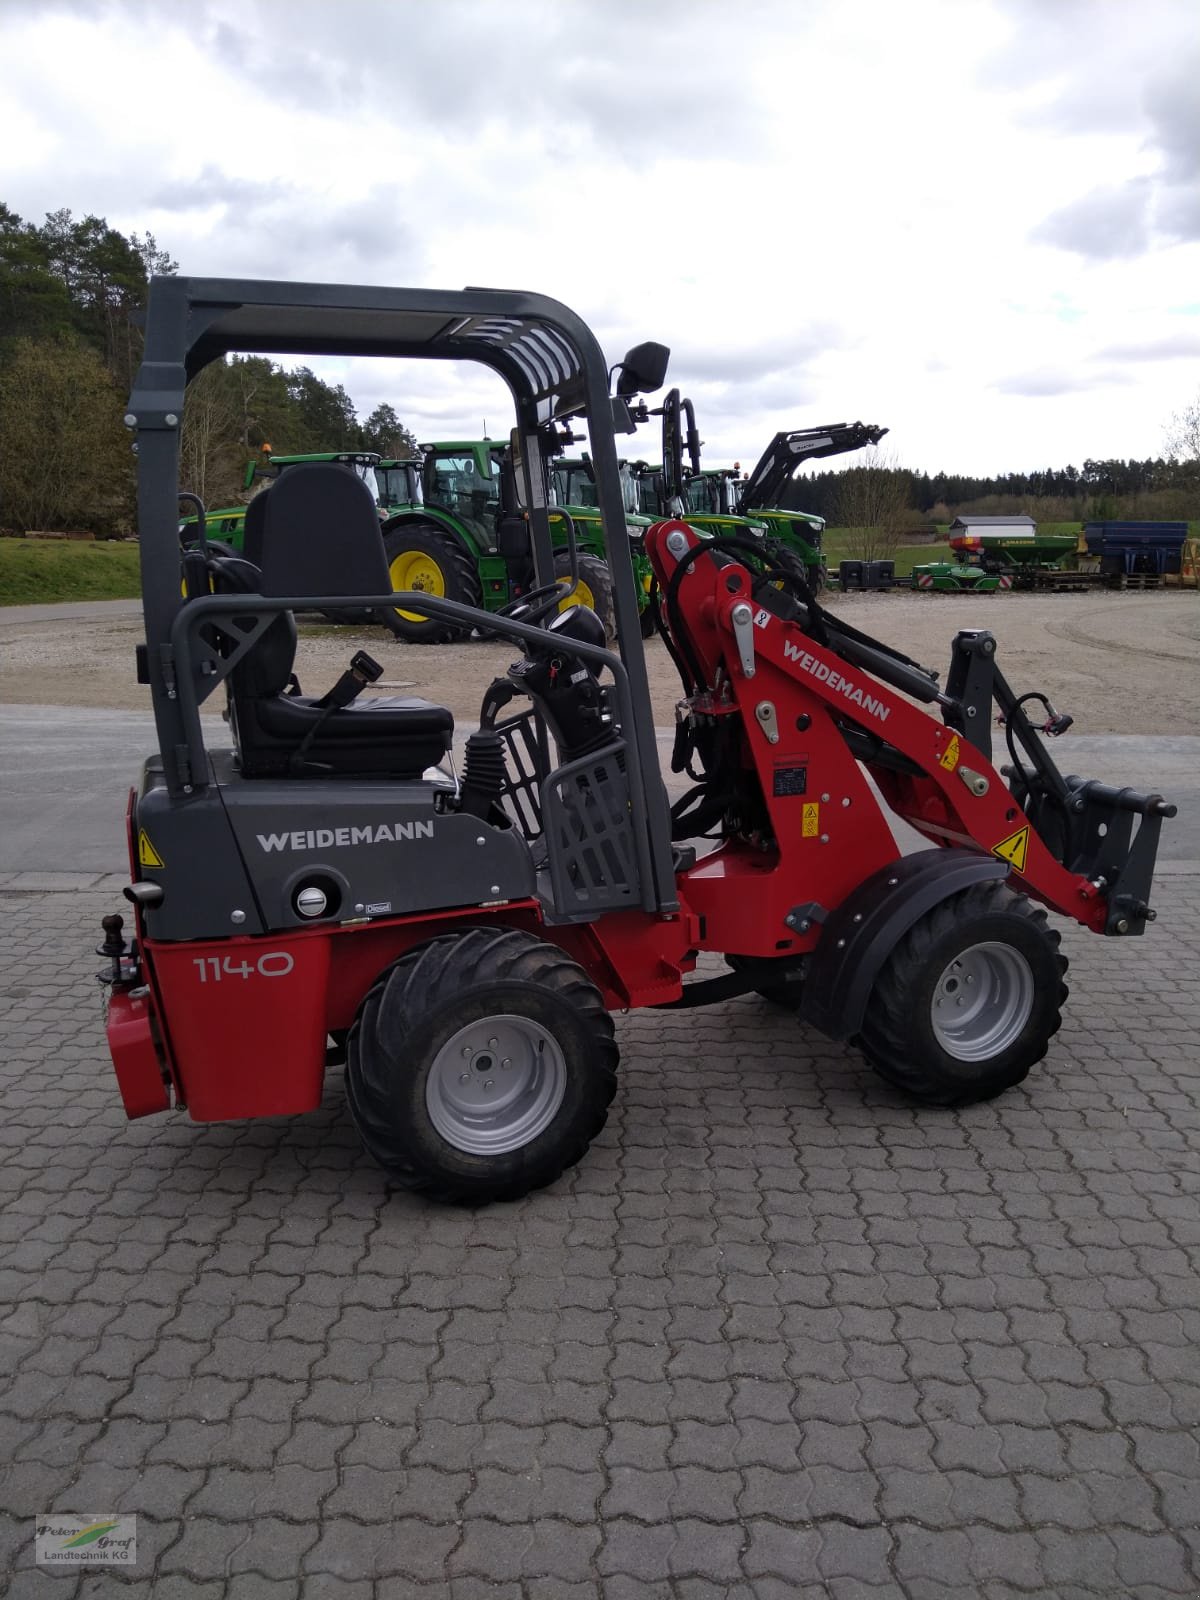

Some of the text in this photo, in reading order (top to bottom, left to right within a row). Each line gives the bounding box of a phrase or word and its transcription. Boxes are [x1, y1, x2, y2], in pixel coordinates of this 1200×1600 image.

[783, 640, 891, 722] WEIDEMANN
[256, 820, 435, 852] WEIDEMANN
[192, 951, 294, 982] 1140
